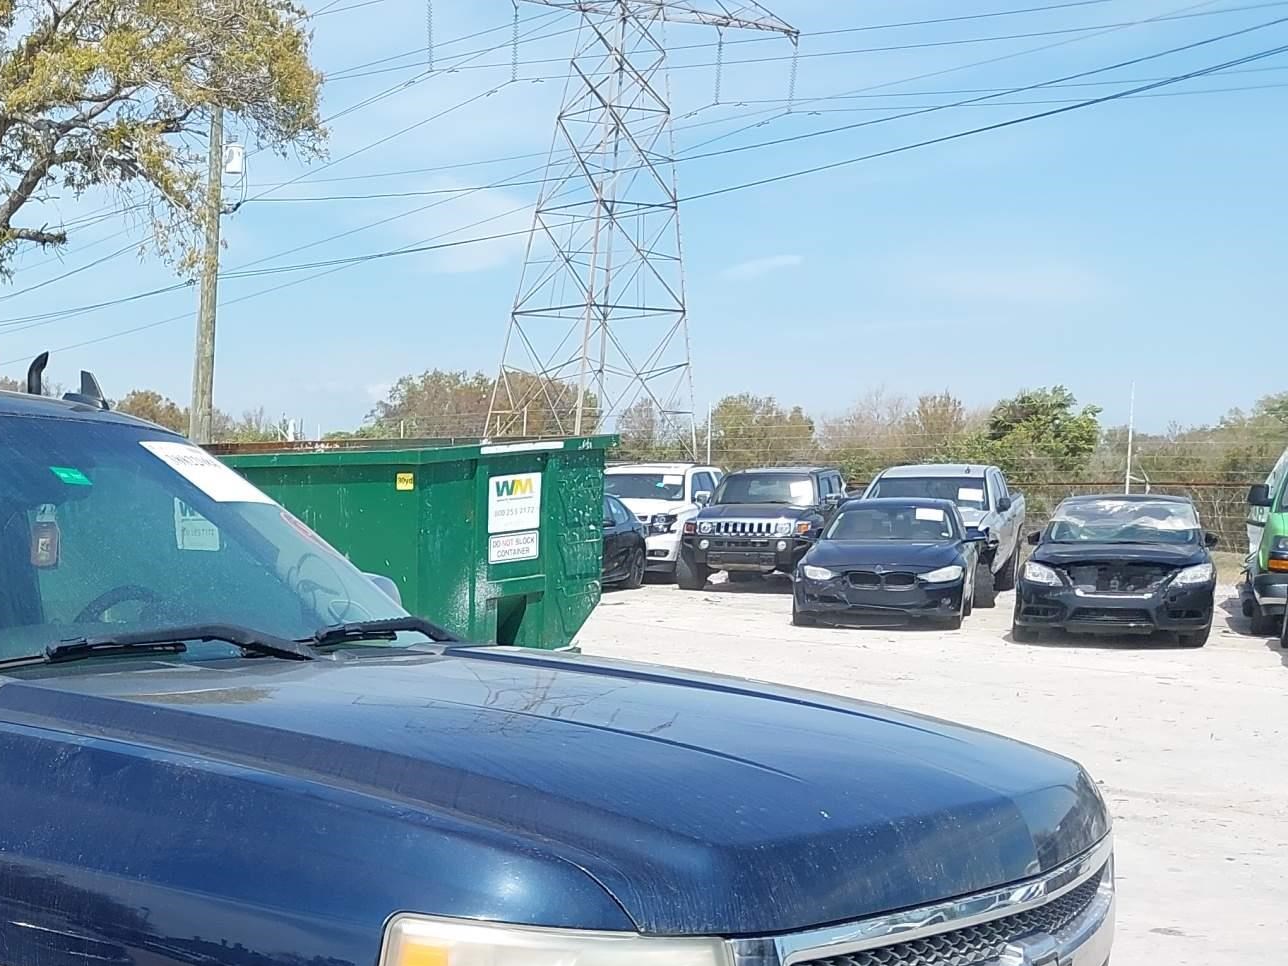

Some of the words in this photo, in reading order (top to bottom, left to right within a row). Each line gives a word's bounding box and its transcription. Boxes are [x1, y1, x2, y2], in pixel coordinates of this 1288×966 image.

[496, 478, 534, 497] WM
[493, 539, 501, 548] DO
[502, 538, 514, 547] NOT
[515, 536, 535, 546] BLOCK
[497, 547, 530, 558] CONTAINER
